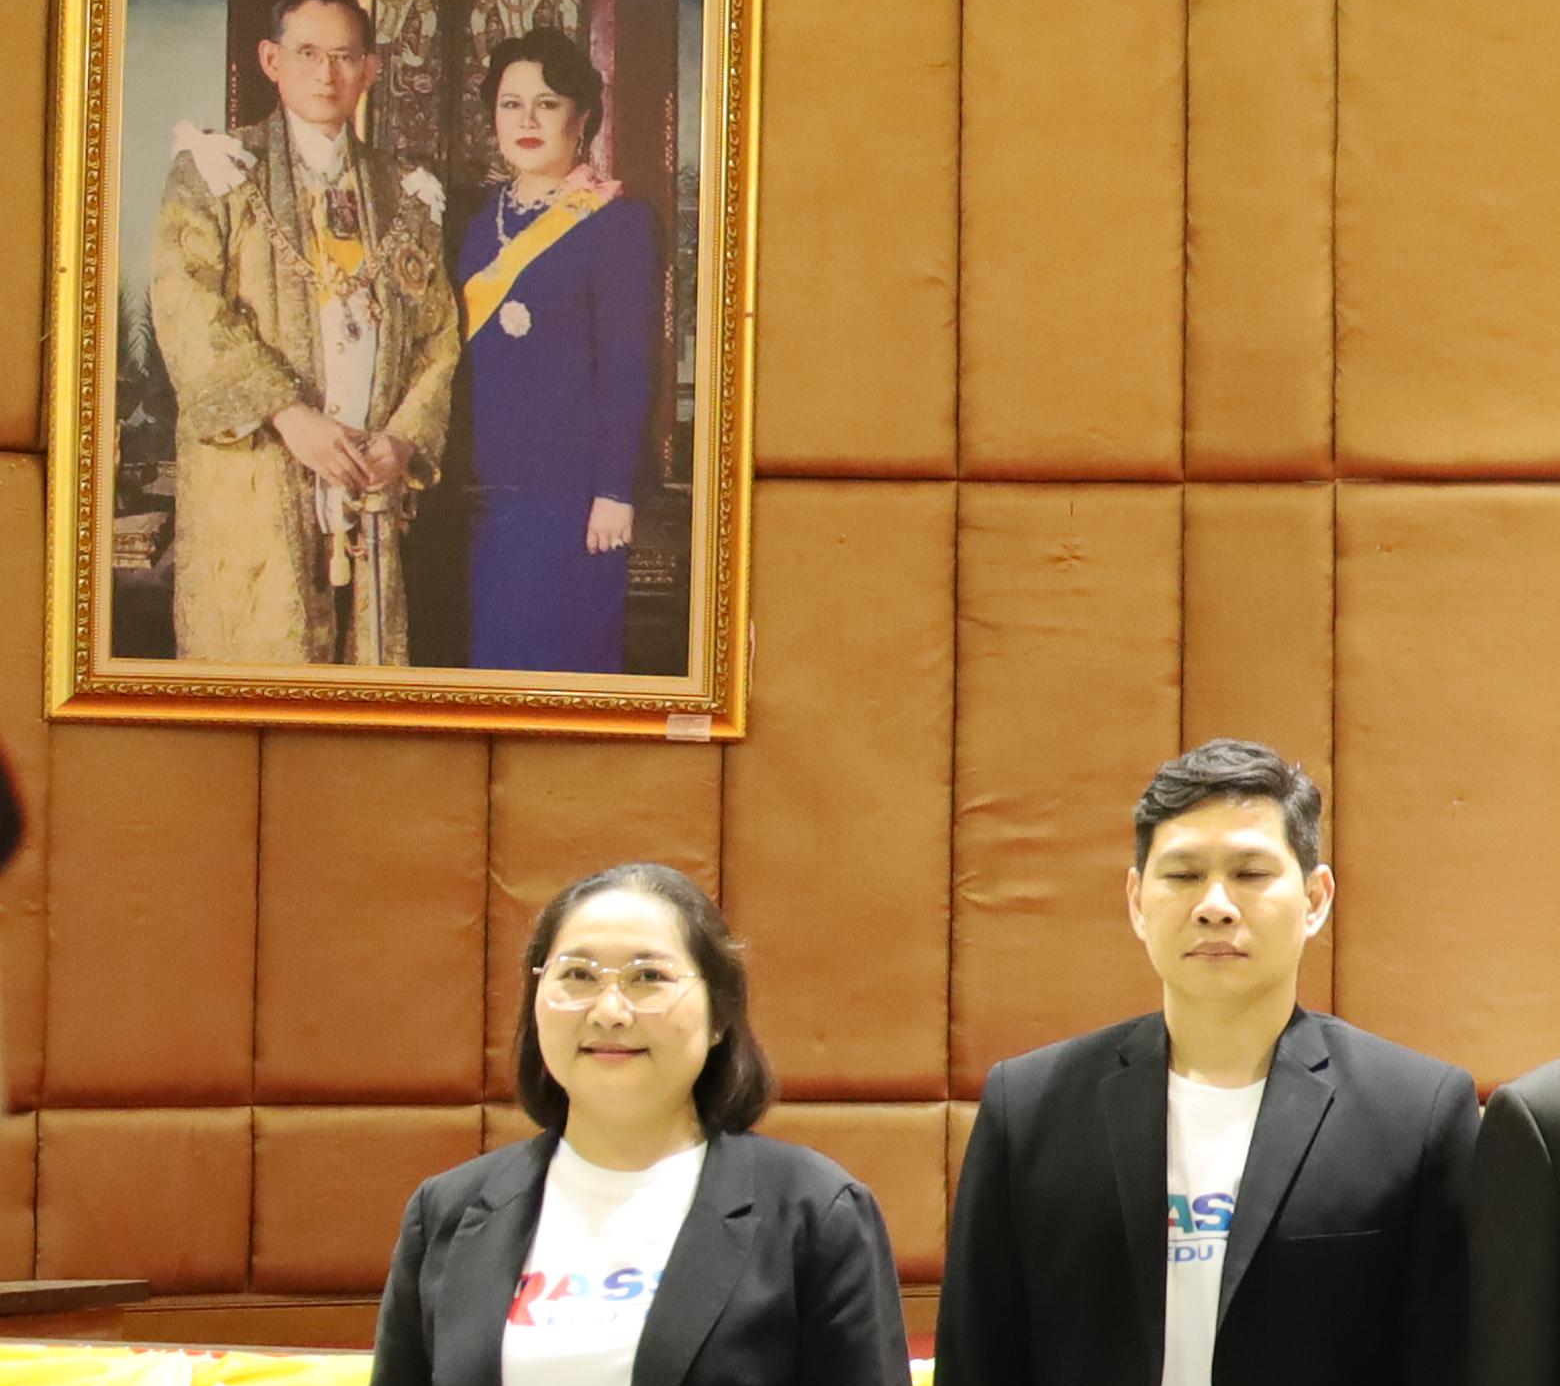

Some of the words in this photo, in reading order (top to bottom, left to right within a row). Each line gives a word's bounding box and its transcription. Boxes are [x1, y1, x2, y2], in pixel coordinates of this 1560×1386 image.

[1168, 1193, 1235, 1234] AS
[1168, 1245, 1214, 1262] DU
[506, 1268, 667, 1327] RAS
